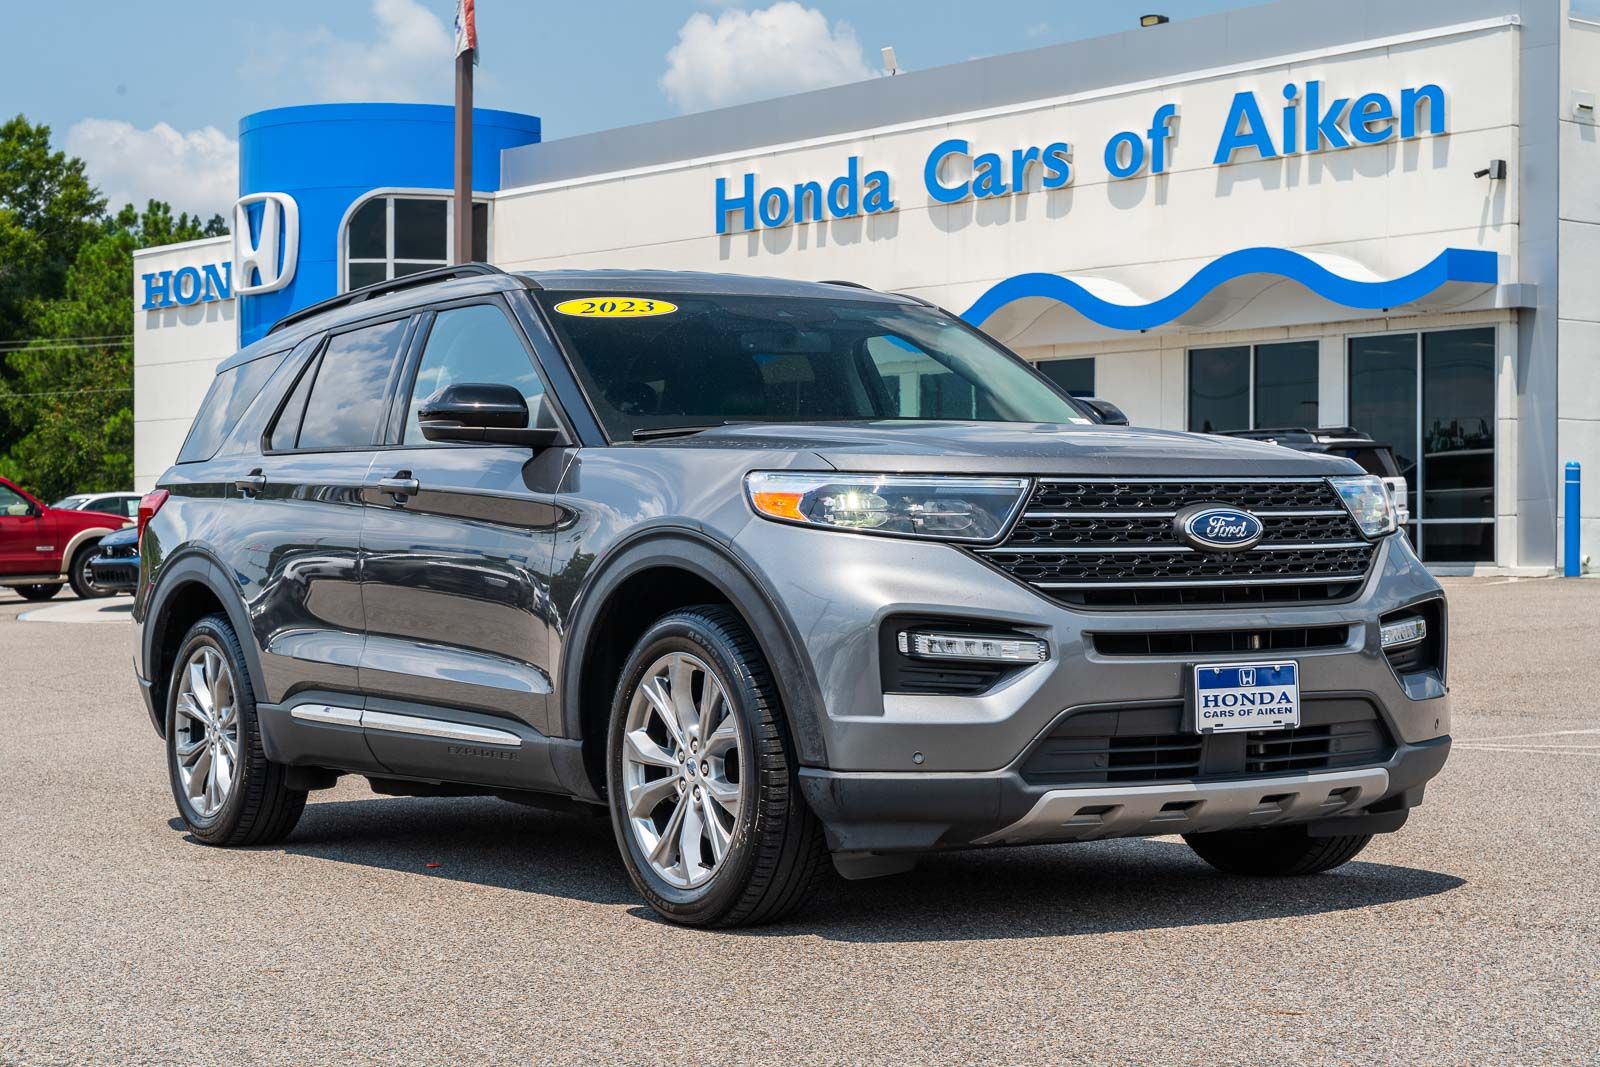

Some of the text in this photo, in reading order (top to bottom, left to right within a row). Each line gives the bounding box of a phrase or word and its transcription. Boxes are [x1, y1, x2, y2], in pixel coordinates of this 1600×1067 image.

[715, 80, 1446, 235] Honda Cars of Aiken
[580, 301, 655, 314] 2023
[1206, 515, 1248, 537] Ford
[1202, 690, 1293, 708] HONDA
[1203, 706, 1293, 718] CARS OF AIKEN
[447, 745, 521, 760] EXPLORER
